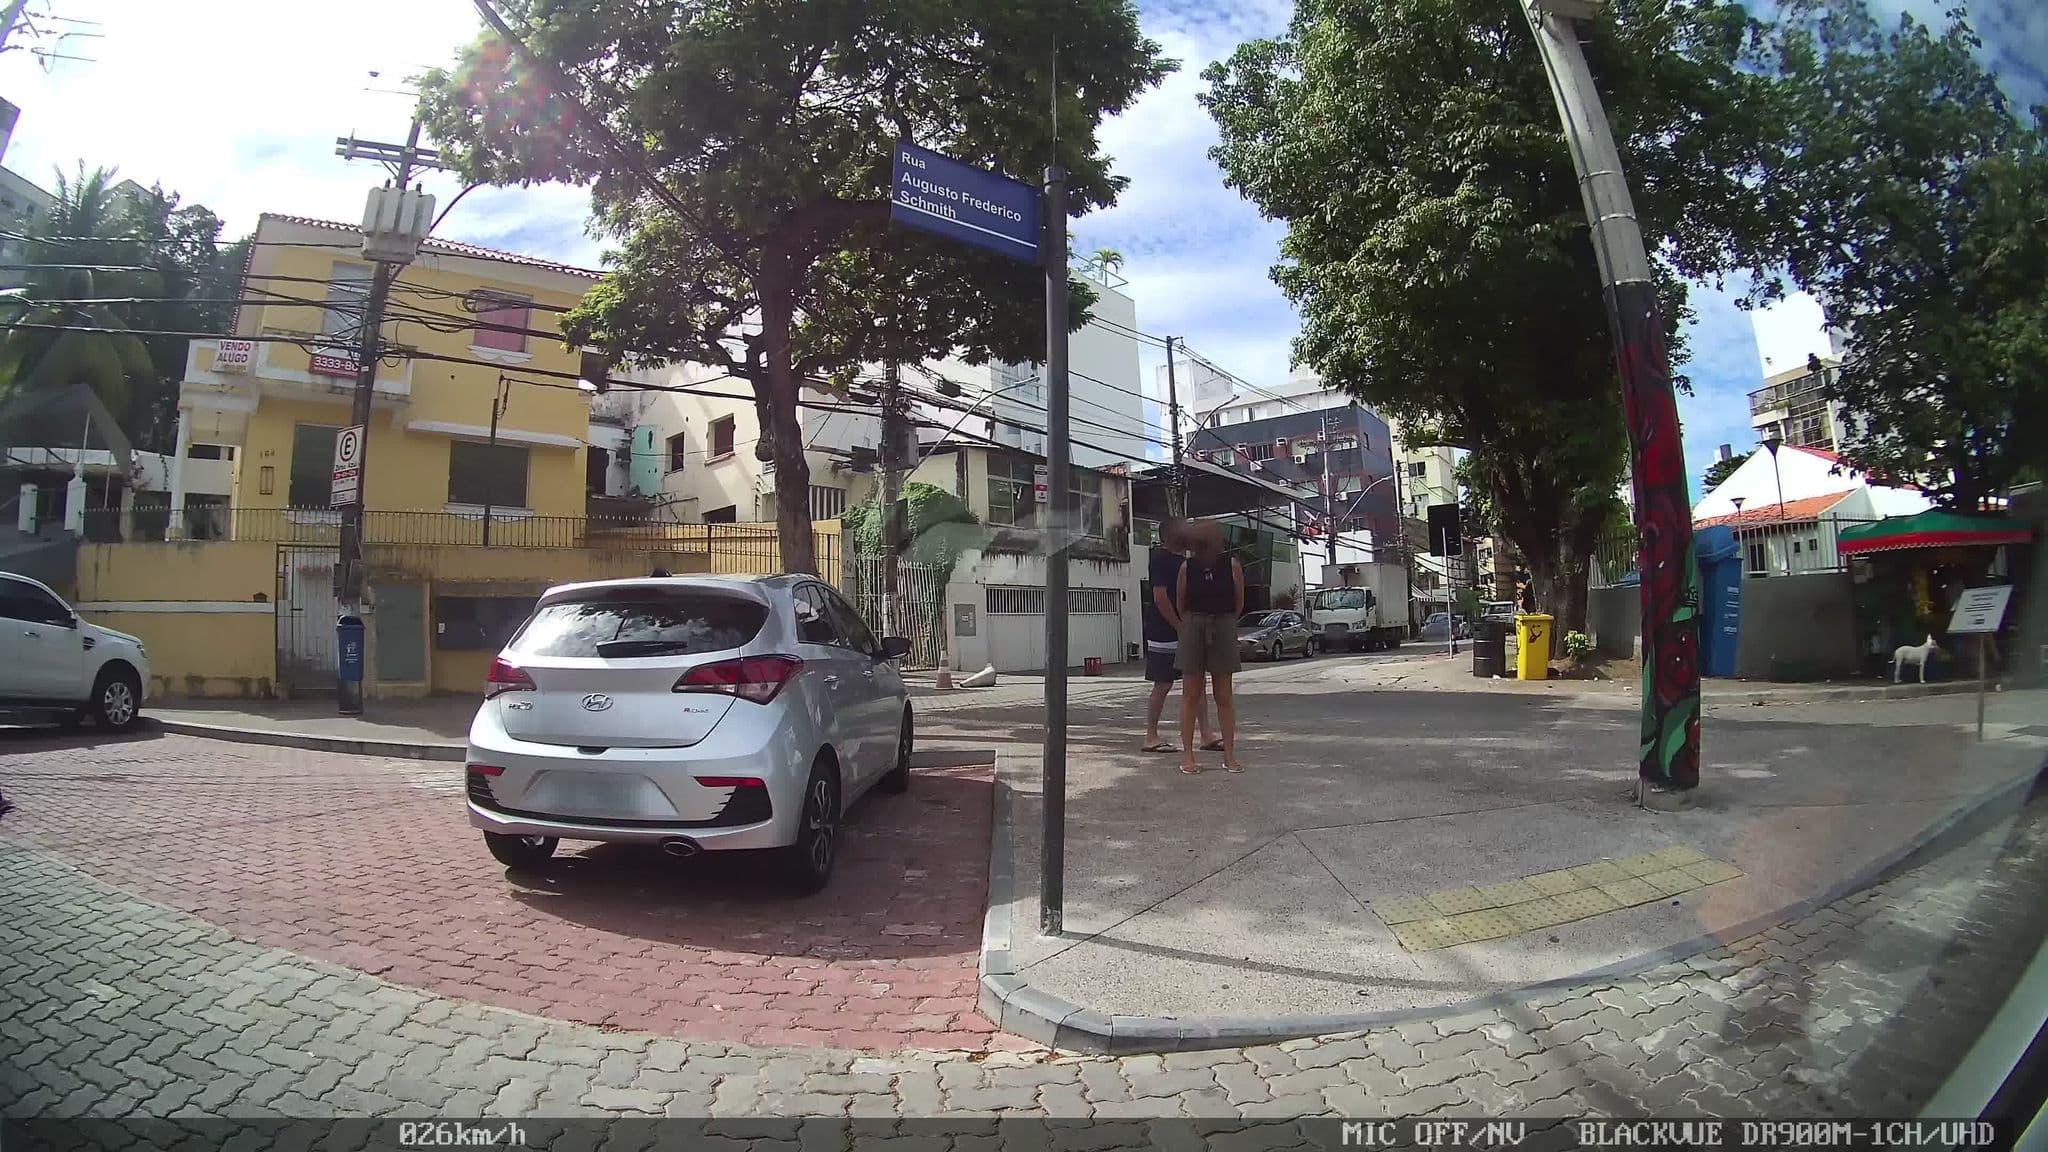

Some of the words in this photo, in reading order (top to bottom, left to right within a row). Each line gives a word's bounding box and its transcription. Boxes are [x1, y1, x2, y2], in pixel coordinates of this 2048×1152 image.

[902, 152, 926, 170] Rua
[900, 190, 957, 219] Schmith
[901, 171, 959, 201] Augusto
[962, 192, 1022, 222] Frederico
[220, 341, 251, 351] VENDO
[216, 352, 248, 363] ALUGO
[344, 437, 352, 456] E
